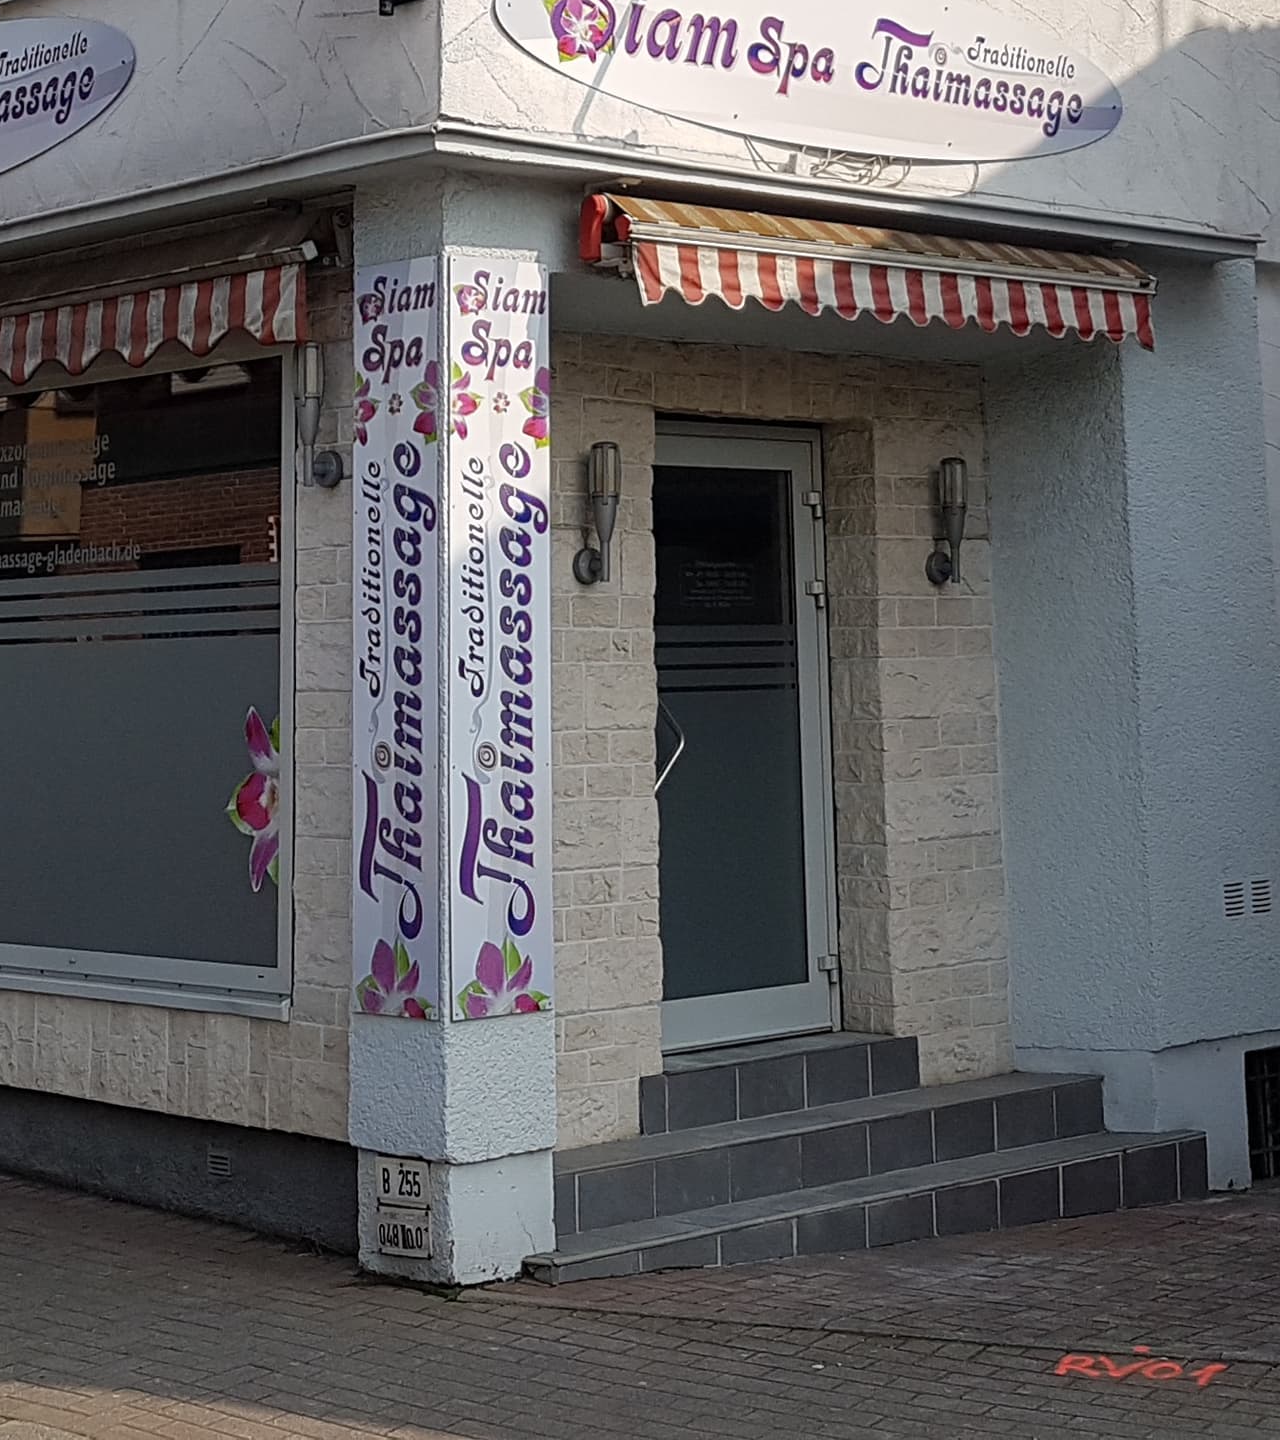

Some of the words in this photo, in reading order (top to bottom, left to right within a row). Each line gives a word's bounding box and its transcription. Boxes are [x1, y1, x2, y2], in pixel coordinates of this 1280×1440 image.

[746, 15, 836, 96] Spa
[854, 17, 1084, 138] Thaimassage
[966, 35, 1076, 80] Traditionelle
[358, 275, 436, 320] Siam
[456, 269, 547, 317] Siam
[362, 324, 424, 385] Spa
[460, 319, 533, 382] Spa
[358, 459, 382, 700] Traditionelle
[456, 455, 485, 700] Traditionelle
[358, 439, 436, 941] Thaimassage
[458, 440, 550, 938] Thaimassage
[381, 1166, 391, 1195] B
[398, 1167, 422, 1198] 255
